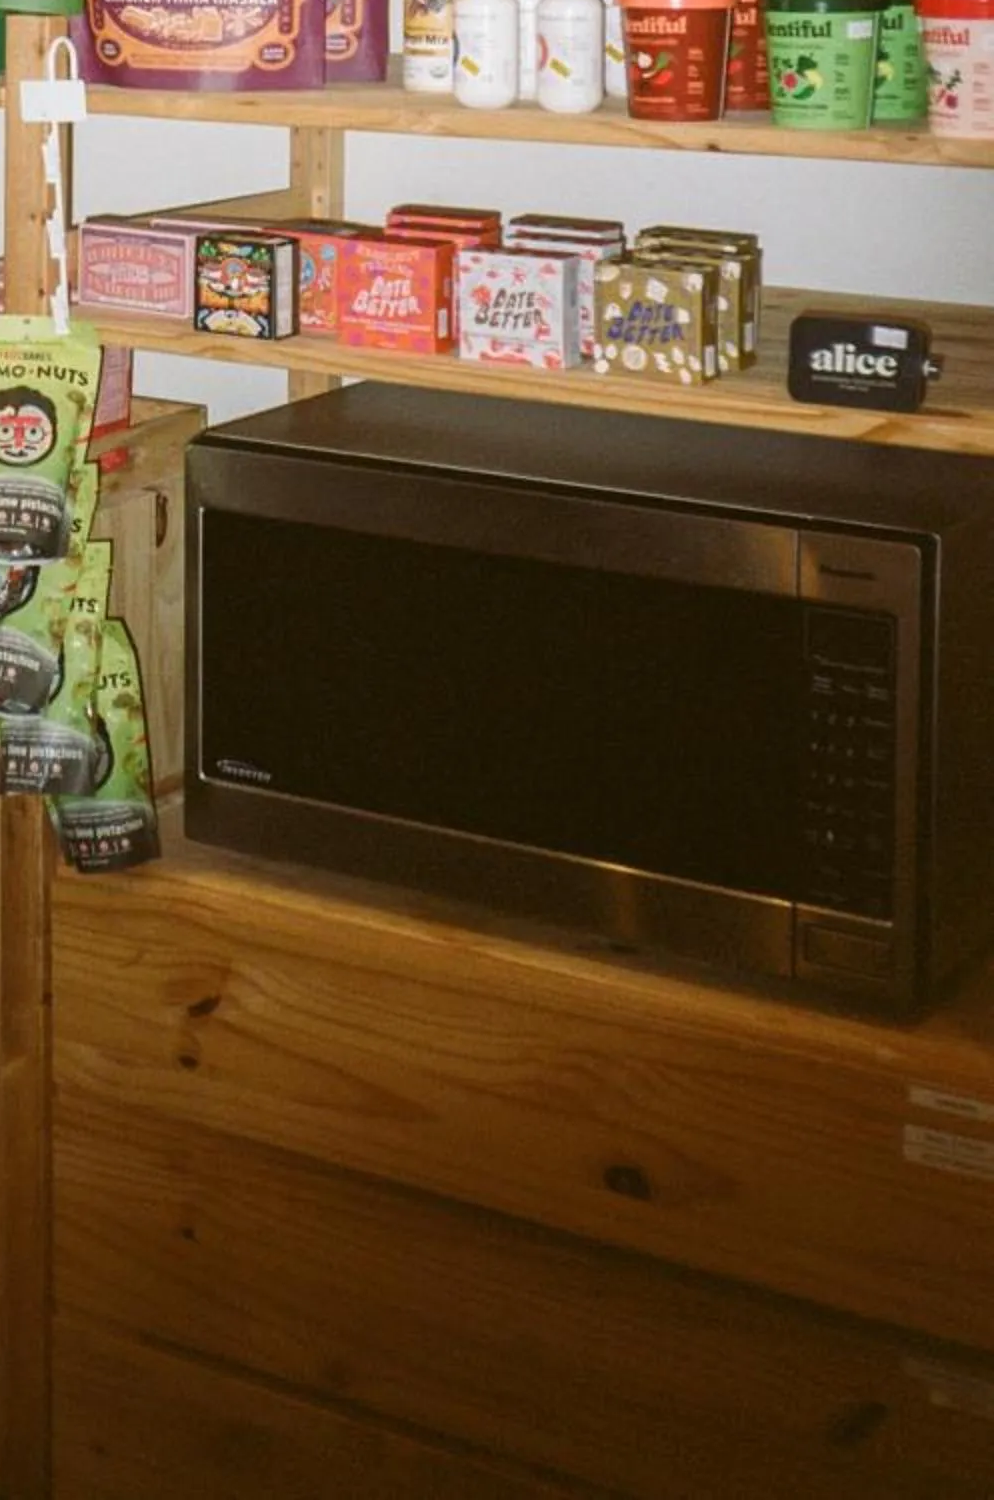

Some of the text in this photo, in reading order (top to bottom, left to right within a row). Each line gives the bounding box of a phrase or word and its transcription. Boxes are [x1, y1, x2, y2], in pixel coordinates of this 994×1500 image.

[493, 288, 536, 309] DATE
[474, 305, 546, 329] BETTER
[628, 301, 675, 321] DATE
[607, 316, 684, 344] BETTER
[810, 343, 898, 377] alice
